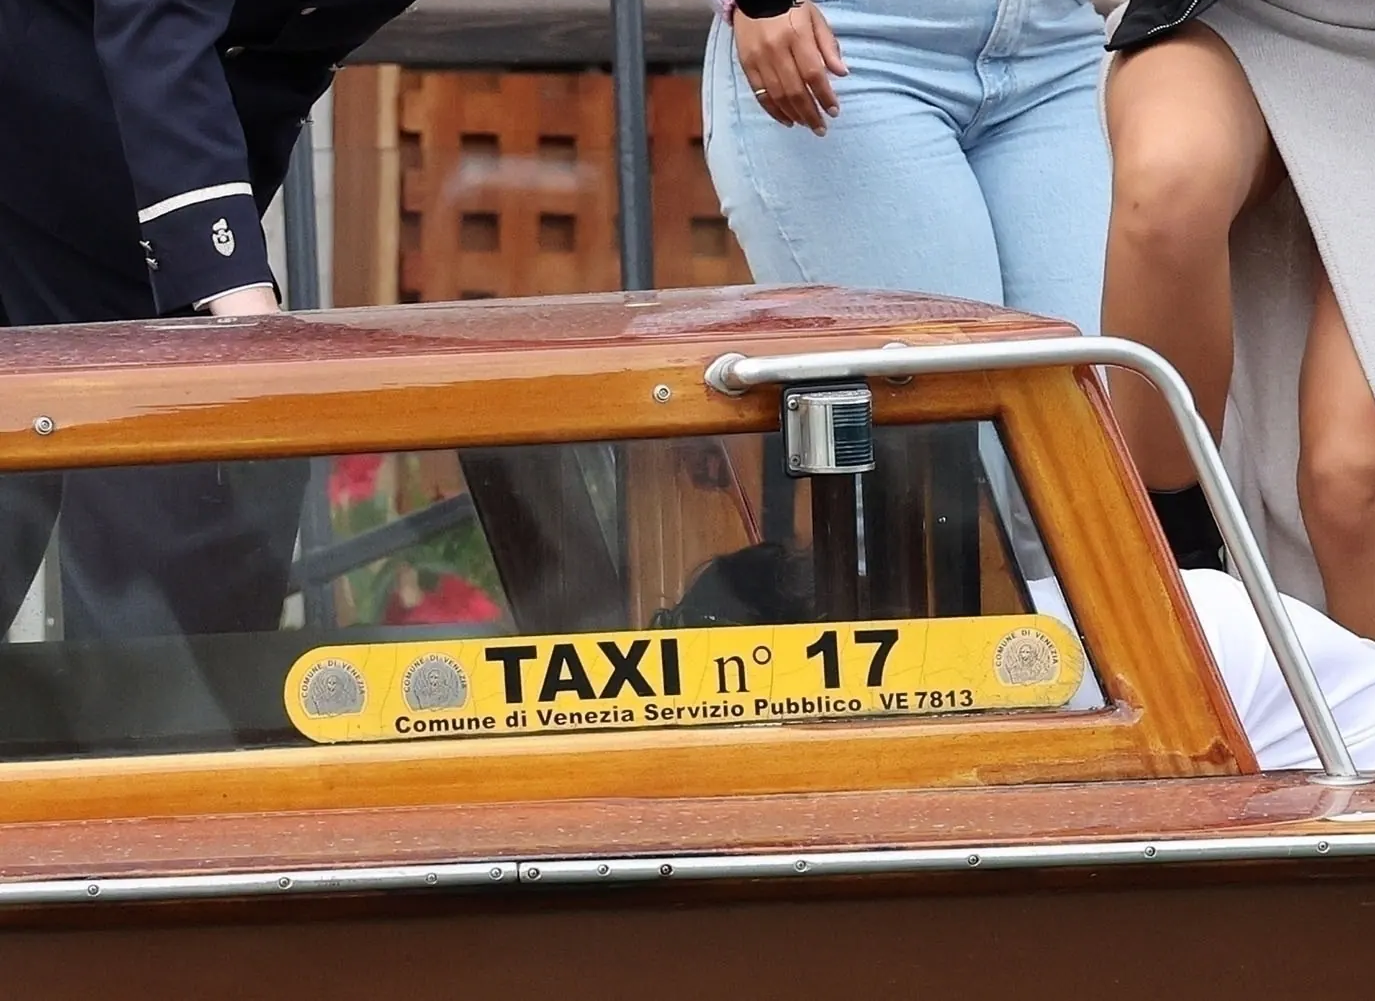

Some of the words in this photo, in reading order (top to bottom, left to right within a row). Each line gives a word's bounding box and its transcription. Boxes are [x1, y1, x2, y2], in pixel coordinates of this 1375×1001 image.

[485, 638, 682, 704] TAXI
[805, 629, 900, 689] 17
[995, 632, 1016, 667] COMUNE
[1021, 629, 1031, 637] DI
[1035, 631, 1059, 665] VENEZIA
[301, 663, 323, 698] COMUNE
[327, 659, 338, 668] DI
[342, 662, 366, 696] VENEZIA
[403, 657, 425, 693] COMUNE
[429, 653, 440, 662] DI
[443, 656, 468, 690] VENEZIA
[394, 714, 497, 734] Comune
[505, 709, 528, 729] di
[537, 705, 635, 726] Venezia
[643, 698, 745, 722] Servizio
[754, 695, 863, 717] Pubblico
[879, 691, 909, 711] VE
[913, 688, 974, 710] 7813
